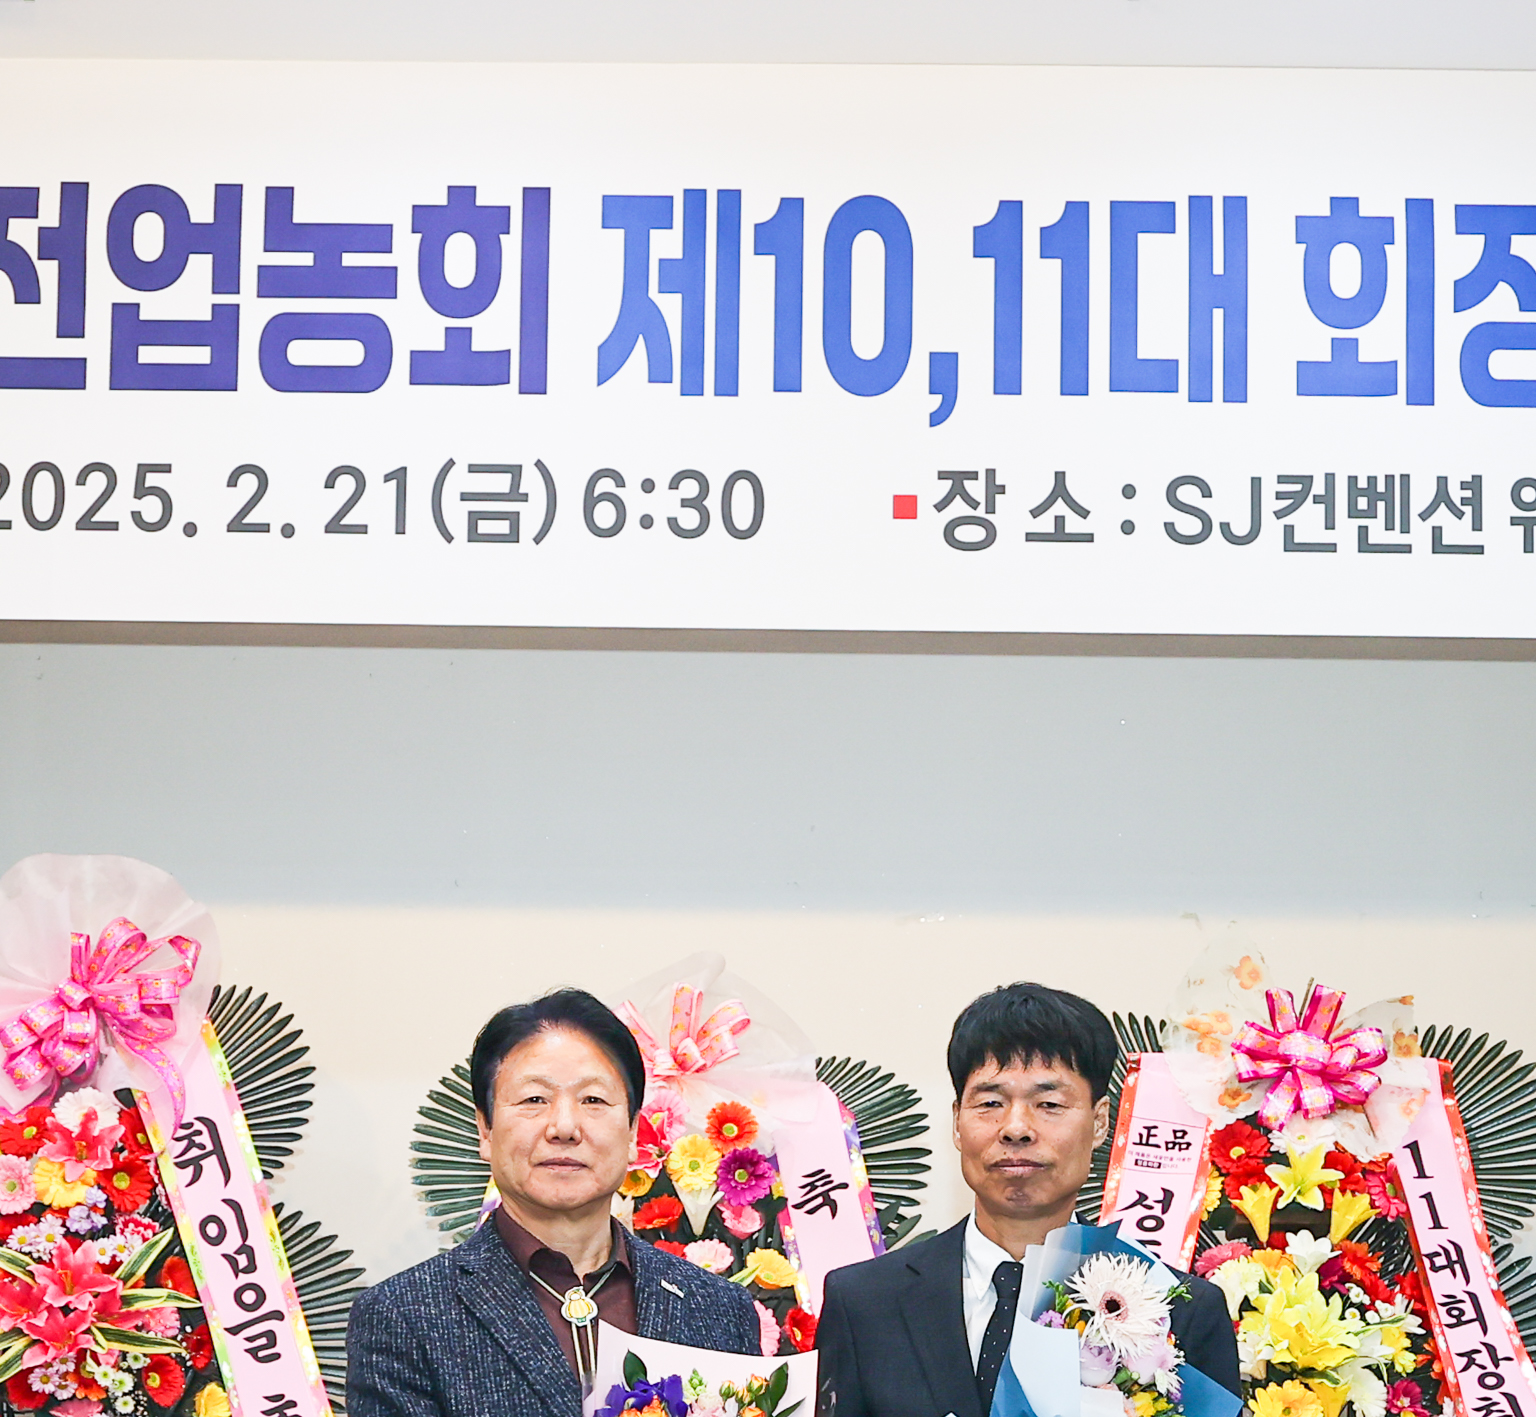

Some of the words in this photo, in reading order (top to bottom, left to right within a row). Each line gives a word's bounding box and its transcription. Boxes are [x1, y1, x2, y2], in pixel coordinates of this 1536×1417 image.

[596, 188, 1248, 427] 제10,11대
[322, 456, 558, 545] 21(금)
[581, 468, 767, 541] 6:30
[1163, 473, 1485, 556] SJ컨벤션
[1132, 1125, 1192, 1152] 正品
[171, 1115, 285, 1363] 취임을
